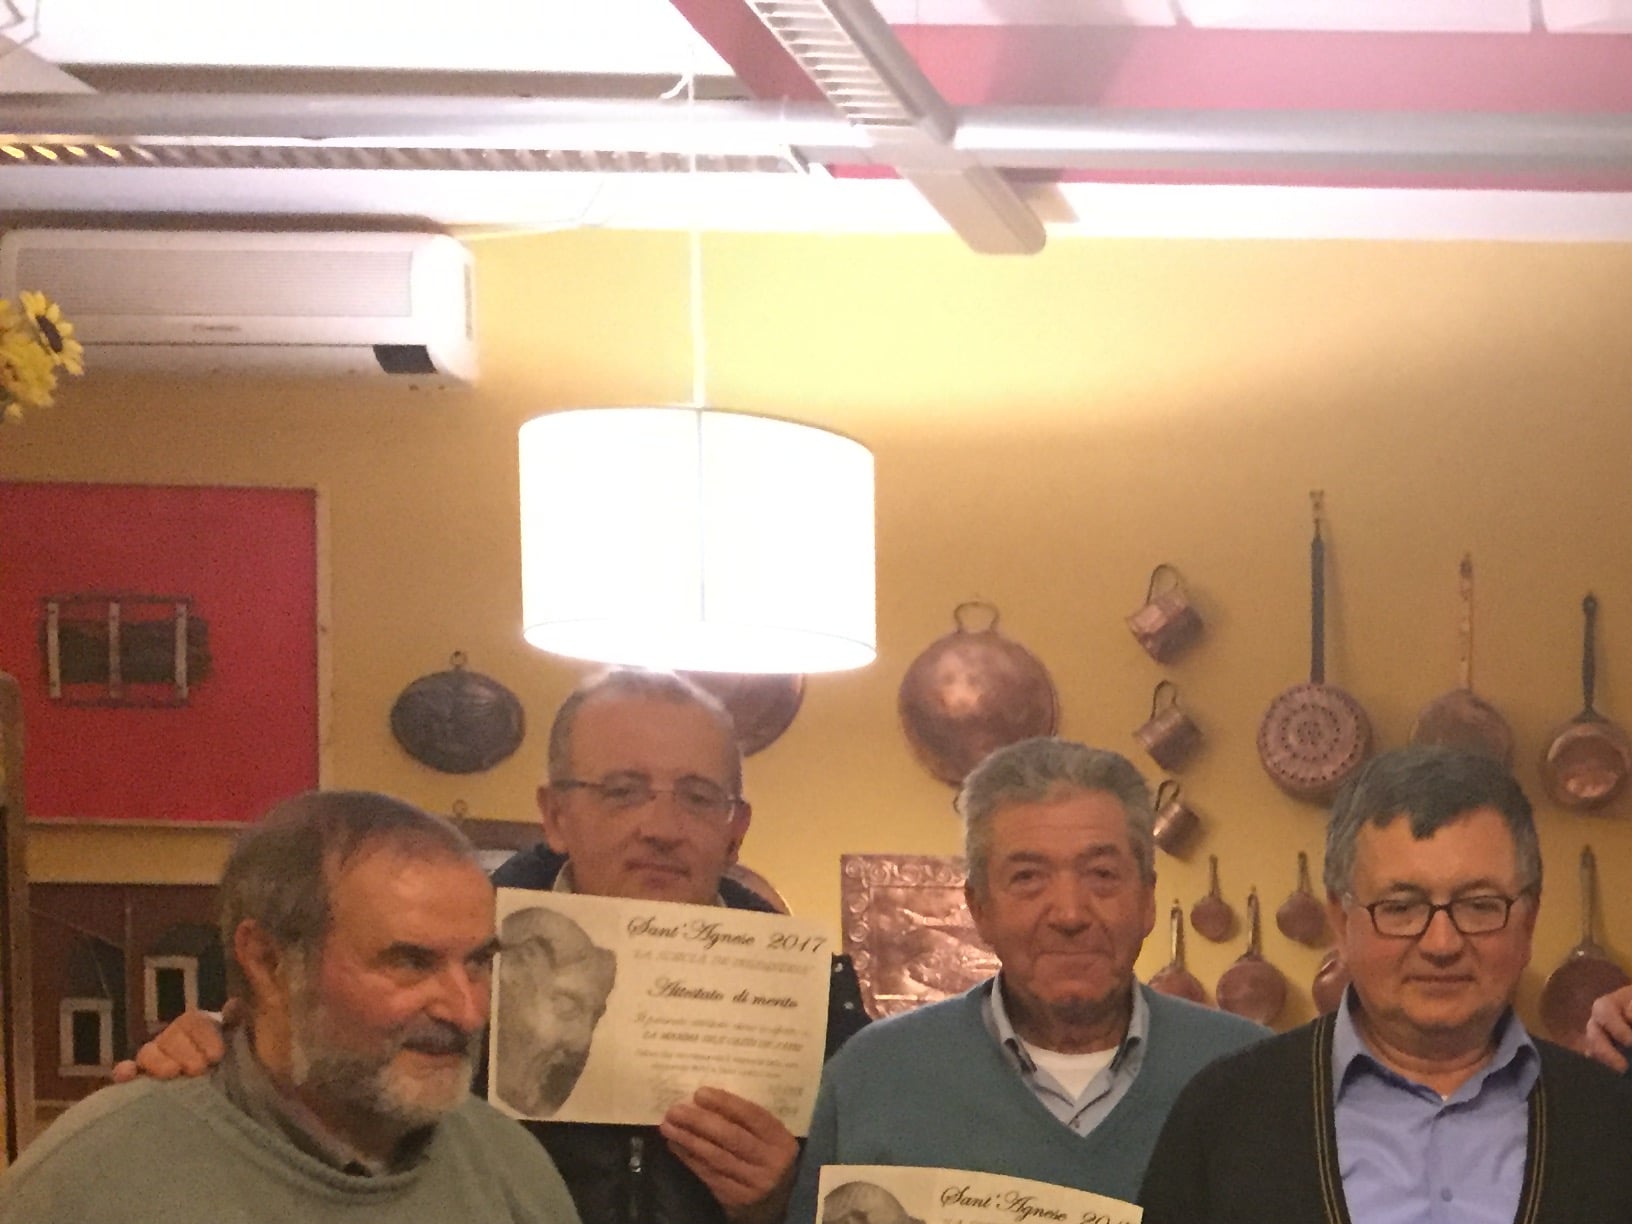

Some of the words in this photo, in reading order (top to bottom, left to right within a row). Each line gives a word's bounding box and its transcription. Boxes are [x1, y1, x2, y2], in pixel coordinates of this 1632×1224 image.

[627, 916, 755, 950] Sant'Agnese
[767, 933, 827, 953] 2017
[647, 978, 724, 1001] Attestato
[732, 989, 749, 1004] di
[751, 996, 798, 1008] merito
[940, 1186, 1067, 1222] Sant'Agnese
